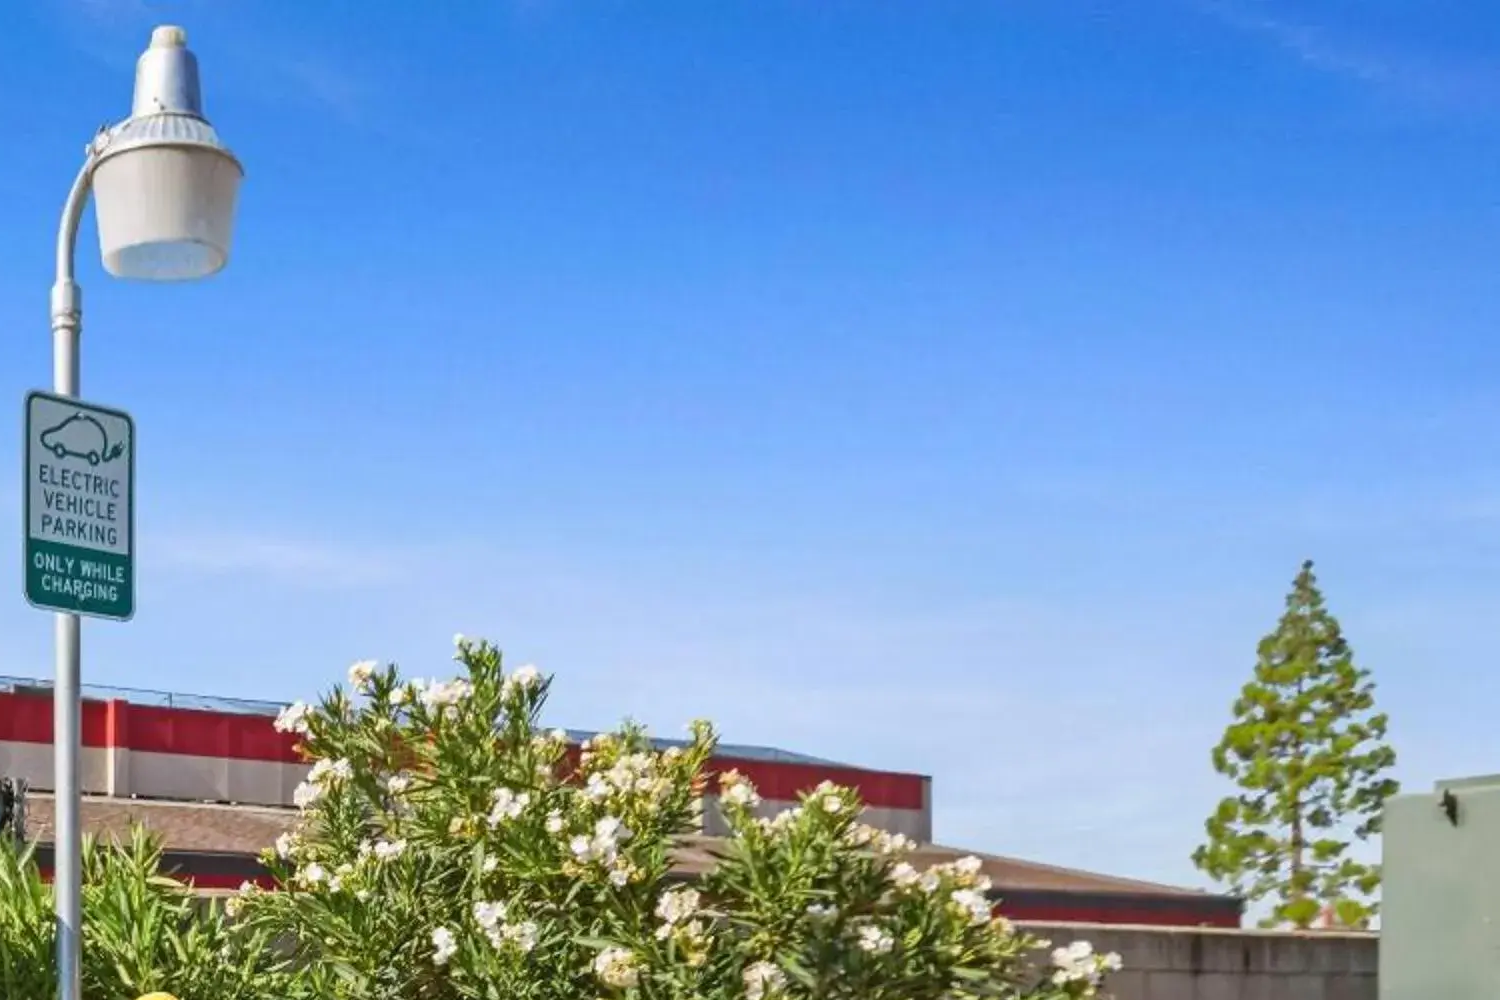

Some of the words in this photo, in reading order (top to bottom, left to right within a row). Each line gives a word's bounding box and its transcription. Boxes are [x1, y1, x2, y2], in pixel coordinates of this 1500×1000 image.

[39, 463, 119, 498] ELECTRIC
[43, 487, 116, 520] VEHICLE
[41, 513, 117, 545] PARKING
[33, 551, 74, 574] ONLY
[80, 559, 125, 583] WHILE
[41, 573, 118, 601] CHARGING
